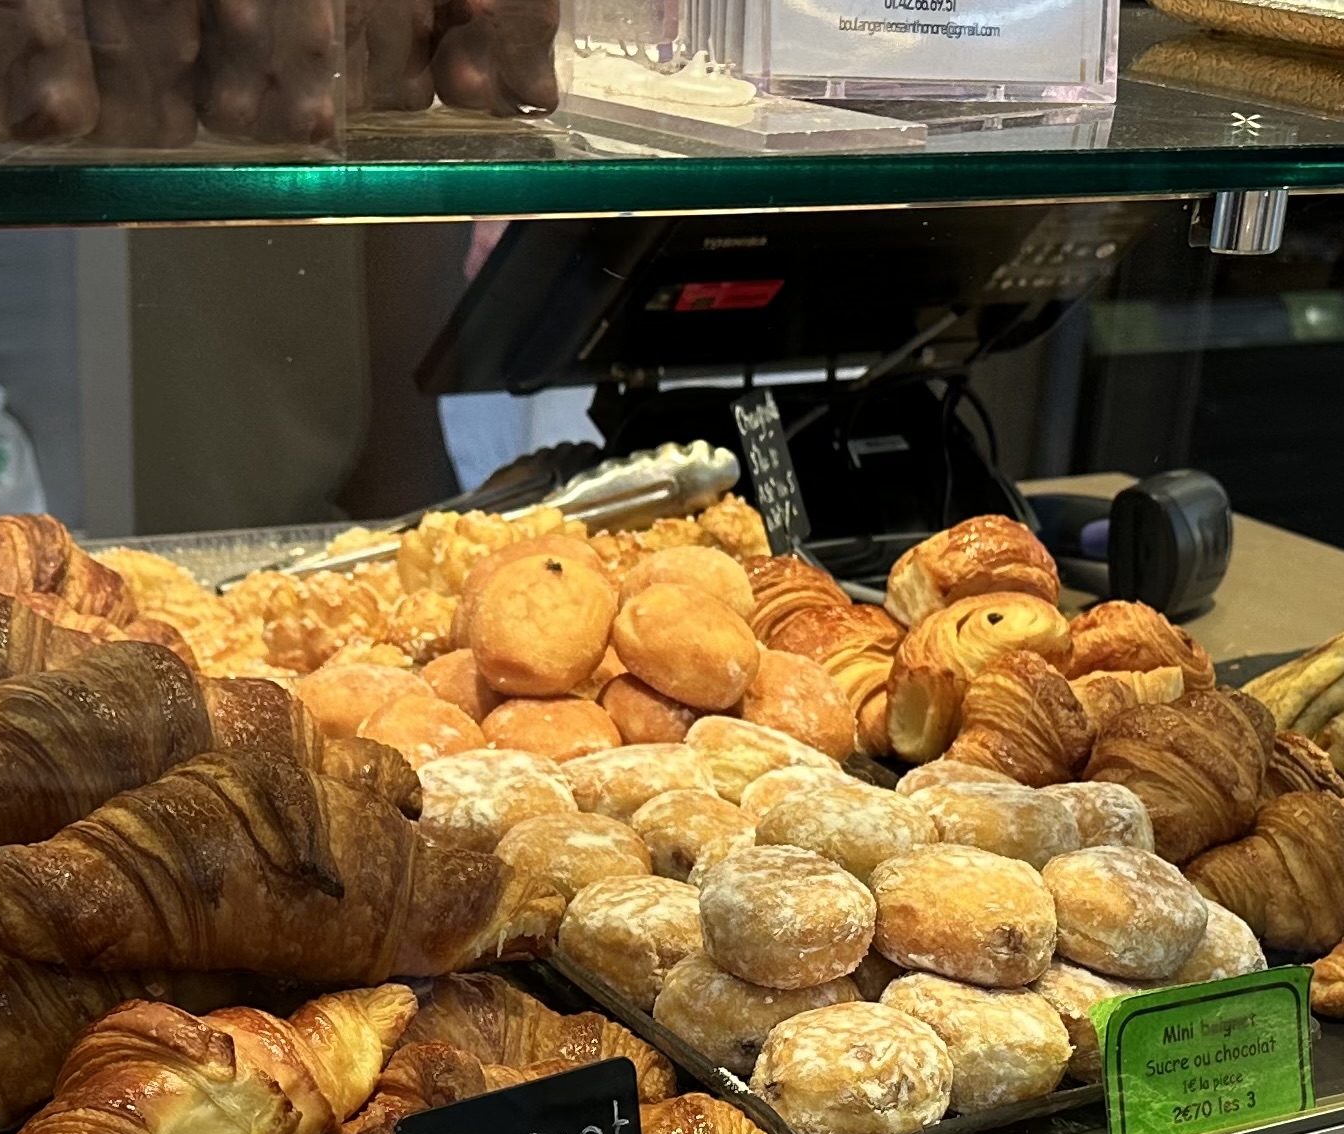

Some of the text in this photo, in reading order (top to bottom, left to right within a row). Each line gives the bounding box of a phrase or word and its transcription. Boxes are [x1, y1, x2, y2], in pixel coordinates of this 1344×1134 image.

[1163, 1024, 1194, 1045] Mini
[1145, 1036, 1277, 1077] Sucre ou chocolat
[1183, 1079, 1197, 1094] 1€
[1199, 1077, 1210, 1090] la
[1172, 1091, 1257, 1124] 2€70 les 3
